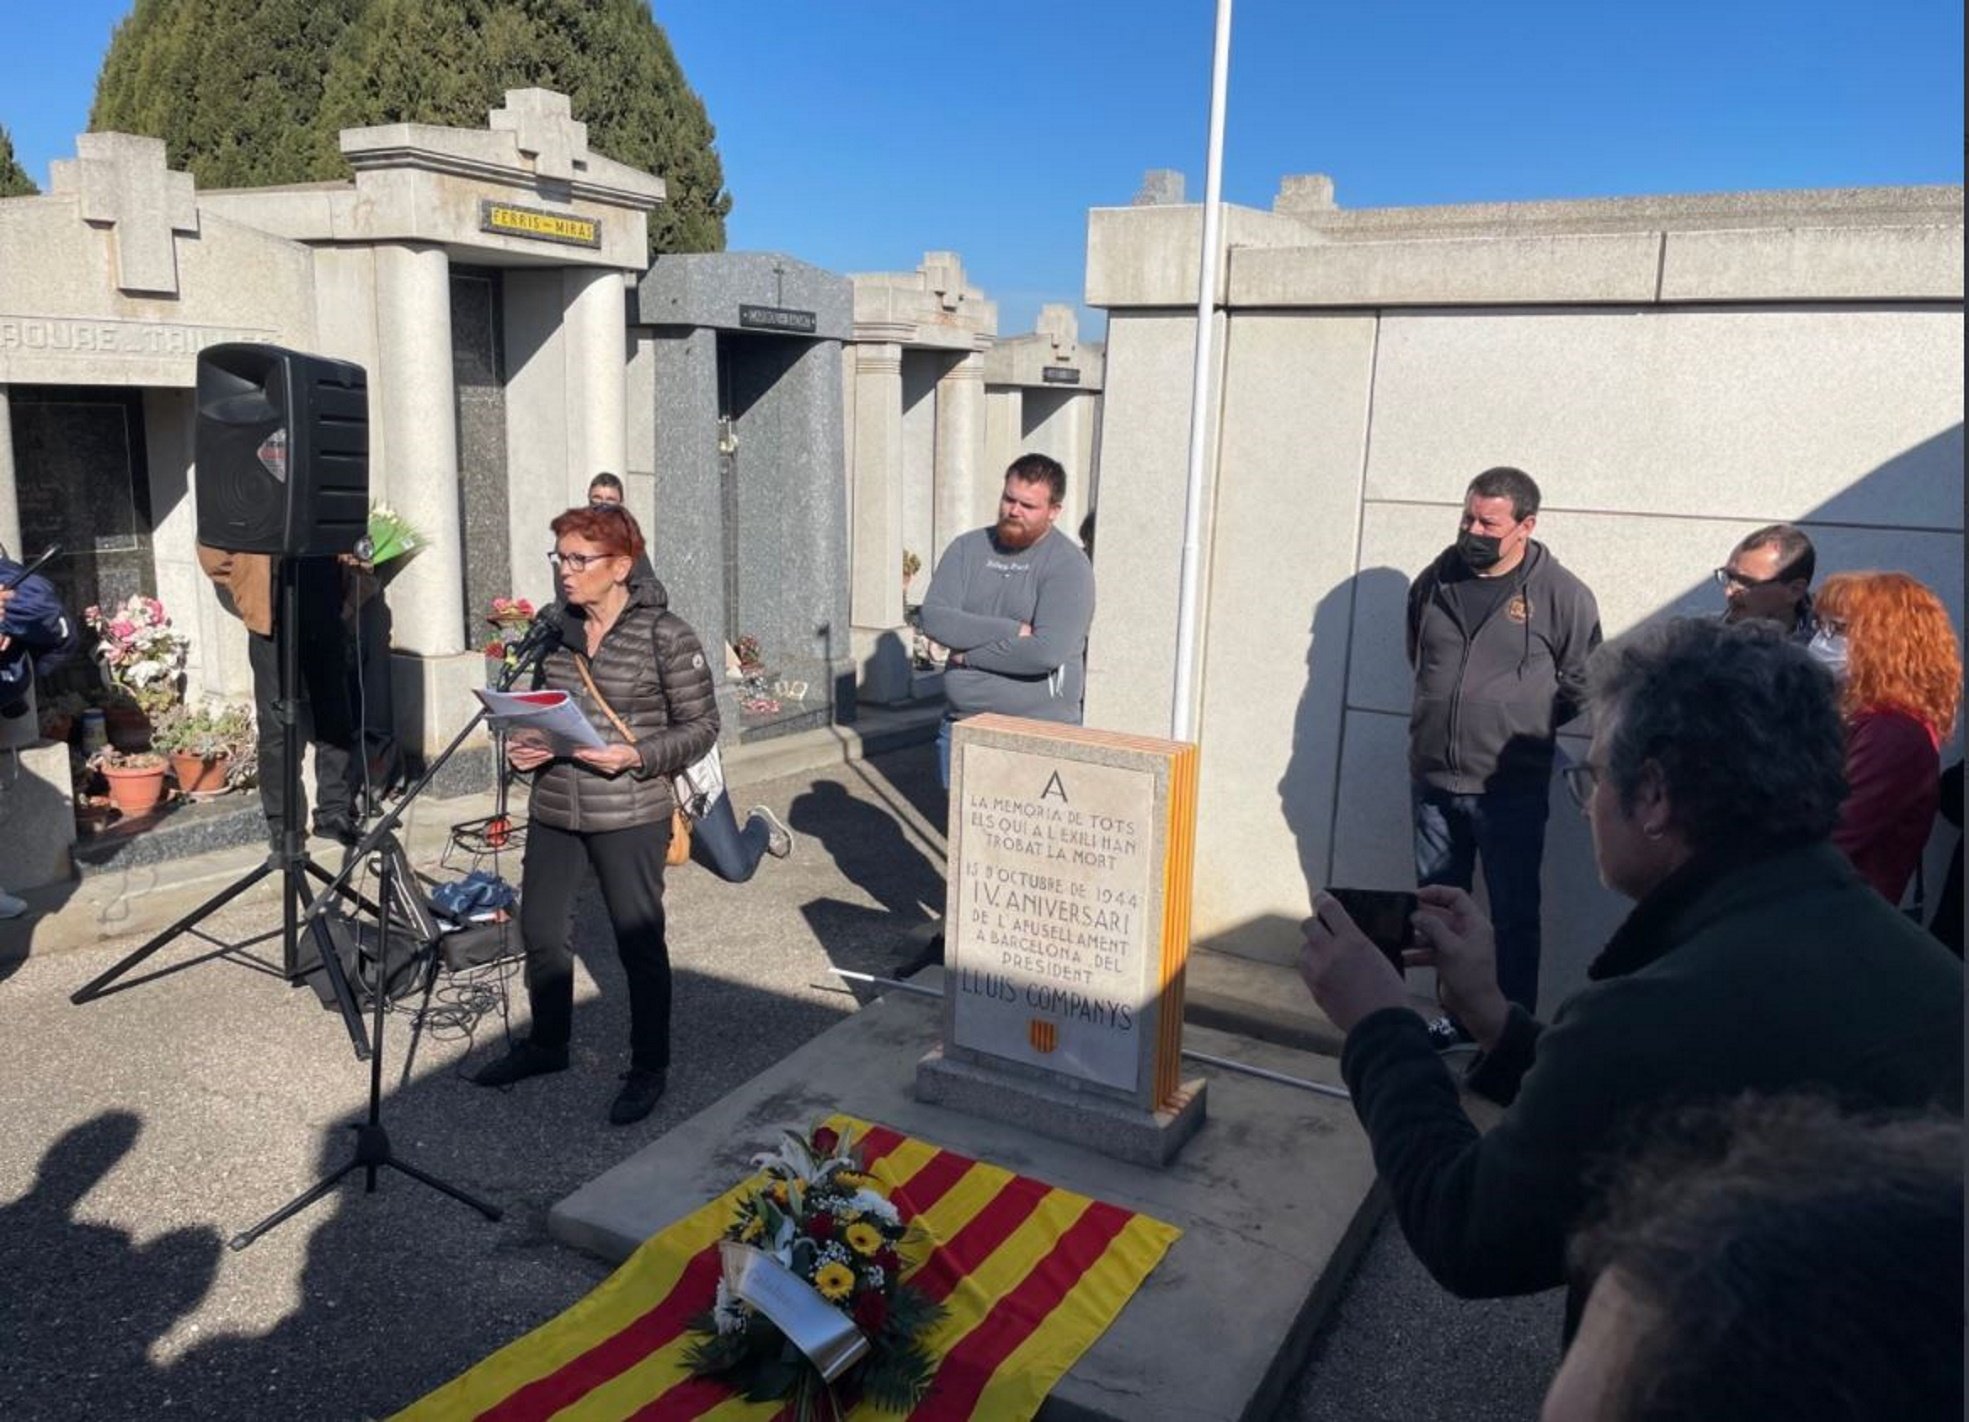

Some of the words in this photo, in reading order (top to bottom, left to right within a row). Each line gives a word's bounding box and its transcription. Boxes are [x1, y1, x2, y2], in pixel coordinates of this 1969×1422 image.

[1040, 769, 1068, 803] A
[971, 797, 987, 810] LA
[993, 798, 1062, 821] MEMORIA
[1068, 811, 1083, 826] DE
[1090, 815, 1135, 835] TOTS
[971, 812, 995, 829] ELS
[1000, 817, 1027, 836] QUI
[1102, 836, 1136, 856] HAN
[986, 833, 1043, 855] TROBAT
[1047, 844, 1066, 860] LA
[1073, 851, 1117, 870] MORT
[966, 862, 978, 877] 15
[1070, 882, 1087, 898] DE
[1096, 887, 1138, 909] 1944
[972, 909, 989, 924] DE
[1006, 891, 1129, 935] ANIVERSARI
[976, 929, 986, 942] A
[991, 931, 1081, 963] BARCELONA
[1094, 954, 1122, 974] DEL
[1002, 951, 1093, 984] PRESIDENT
[1026, 983, 1133, 1031] COMPANYS
